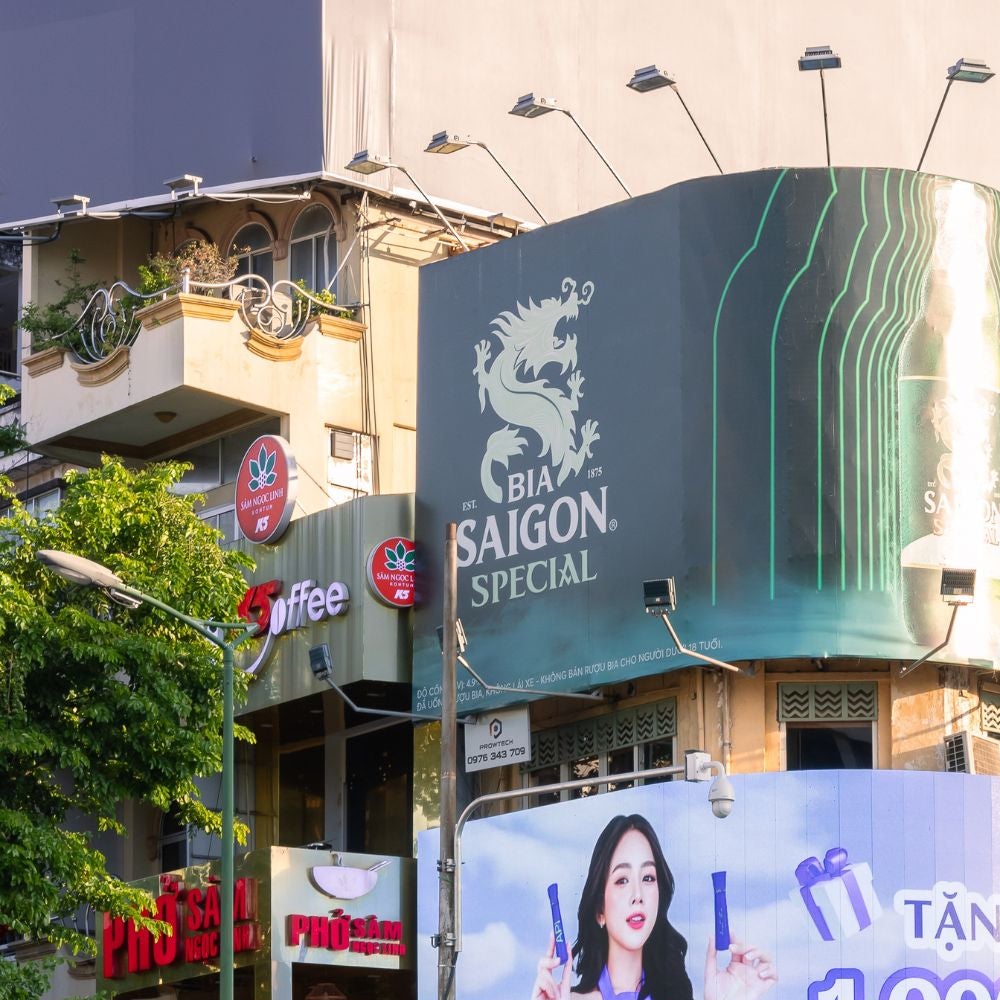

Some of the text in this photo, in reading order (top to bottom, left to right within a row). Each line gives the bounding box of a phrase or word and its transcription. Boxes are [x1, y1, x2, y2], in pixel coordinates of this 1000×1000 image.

[587, 467, 603, 479] 1875
[508, 465, 554, 503] BIA
[270, 487, 284, 502] LINH
[462, 500, 478, 511] EST.
[255, 516, 269, 533] K5
[456, 486, 608, 568] SAIGON
[471, 550, 597, 608] SPECIAL
[394, 589, 410, 599] K5
[607, 660, 619, 671] BIA
[620, 655, 637, 668] CHO
[688, 642, 697, 652] 18
[480, 739, 514, 750] PROWTECH
[490, 750, 507, 760] 343
[510, 747, 526, 757] 709
[287, 909, 351, 951] PHỞ
